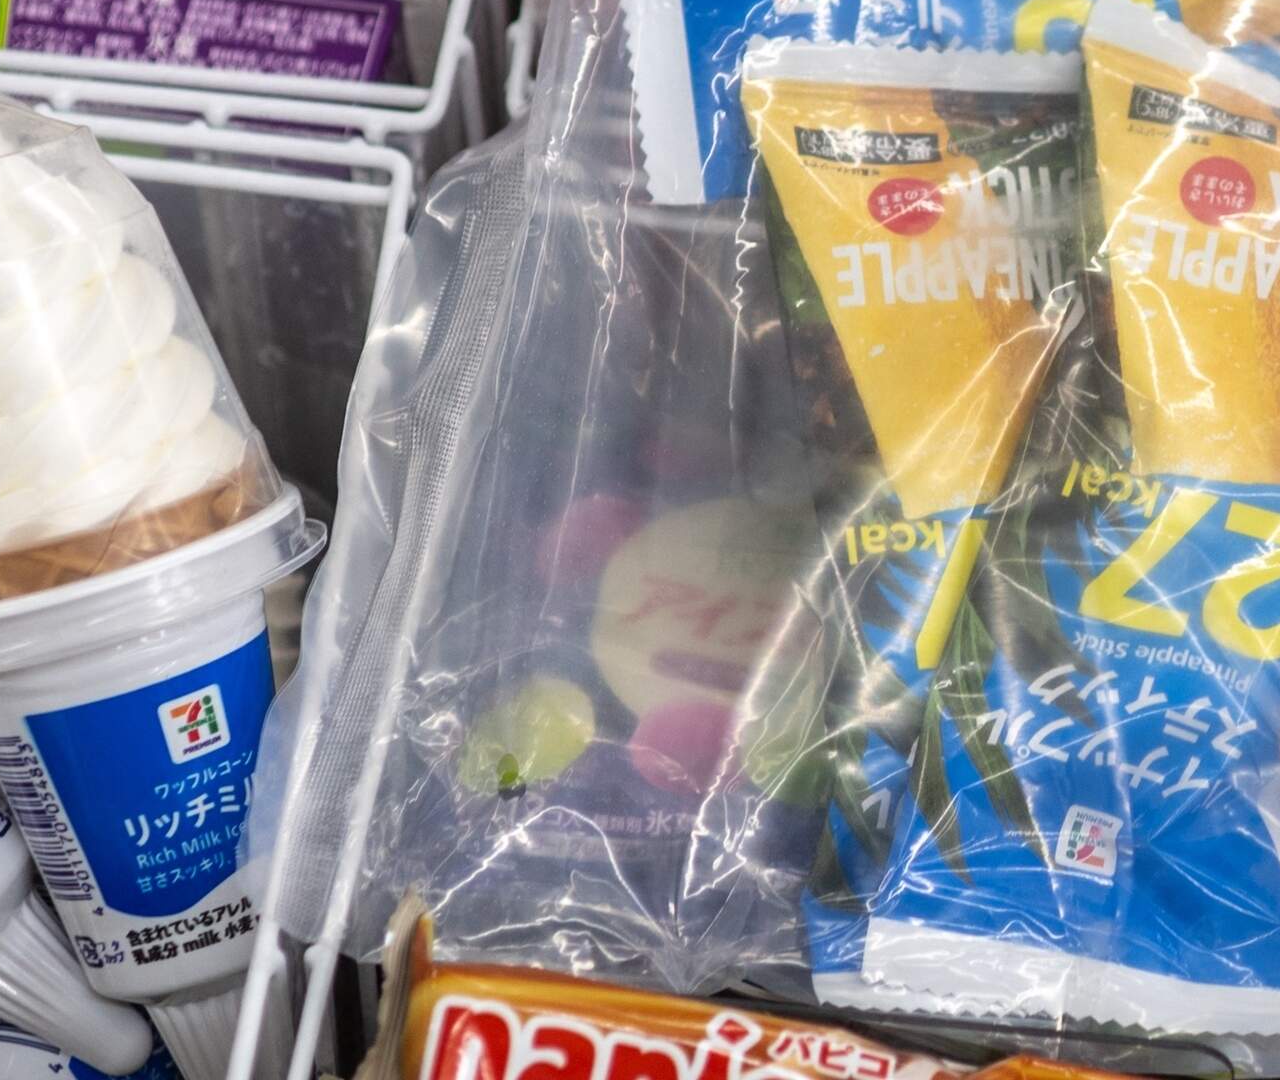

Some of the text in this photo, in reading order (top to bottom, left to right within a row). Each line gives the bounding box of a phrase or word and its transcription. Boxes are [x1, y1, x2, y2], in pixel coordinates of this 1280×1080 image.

[1187, 188, 1247, 210] おいしさ
[1190, 172, 1248, 192] そのまま
[1062, 458, 1169, 520] kcal
[846, 518, 946, 567] kcal
[1071, 631, 1253, 693] Pineapple Stick
[1027, 662, 1257, 760] スティック
[154, 750, 254, 801] ワッフルコーン
[18, 742, 104, 917] 4 901170 054823
[136, 847, 177, 870] Rich
[181, 831, 223, 858] Milk
[126, 895, 253, 948] 含まれているアレル
[131, 937, 180, 967] 乳成分
[183, 929, 223, 955] milk
[773, 1029, 898, 1079] パピコ
